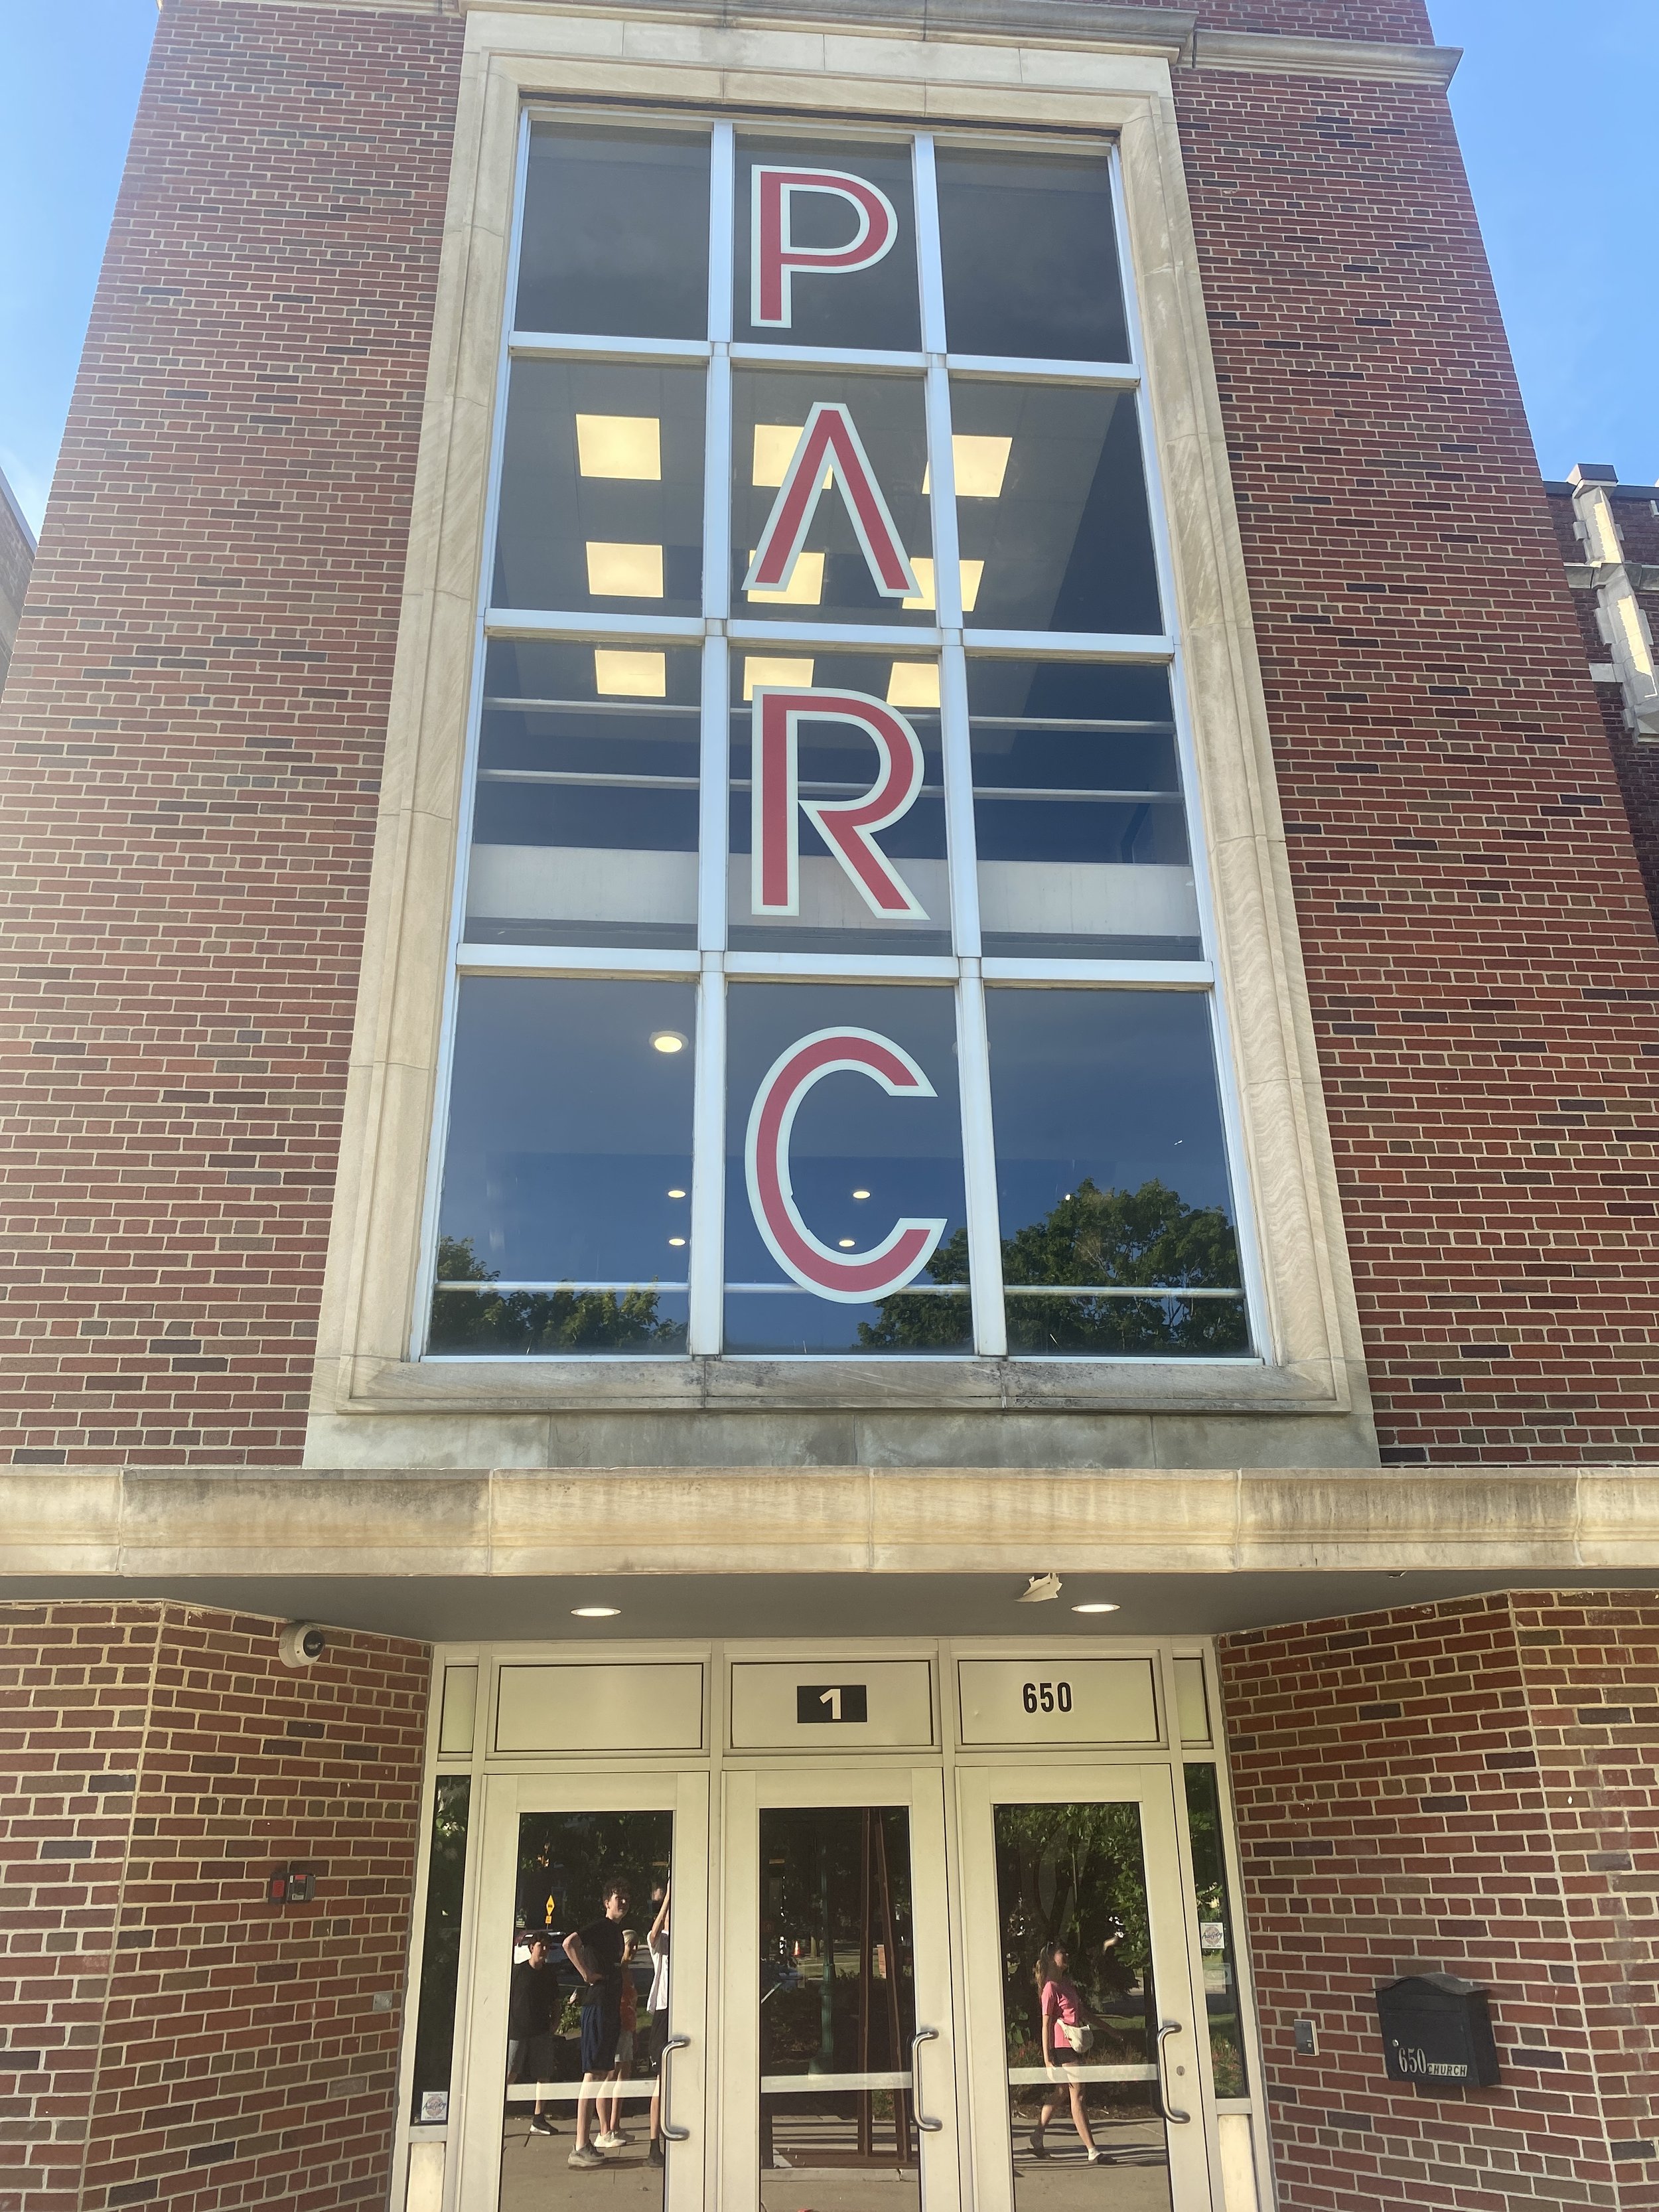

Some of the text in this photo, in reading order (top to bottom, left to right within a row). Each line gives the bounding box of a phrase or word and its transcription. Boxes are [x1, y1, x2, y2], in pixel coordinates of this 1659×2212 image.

[742, 164, 948, 1303] PARC
[819, 1688, 841, 1720] 1
[1023, 1682, 1072, 1714] 650
[1398, 2047, 1466, 2076] 650 CHURCH
